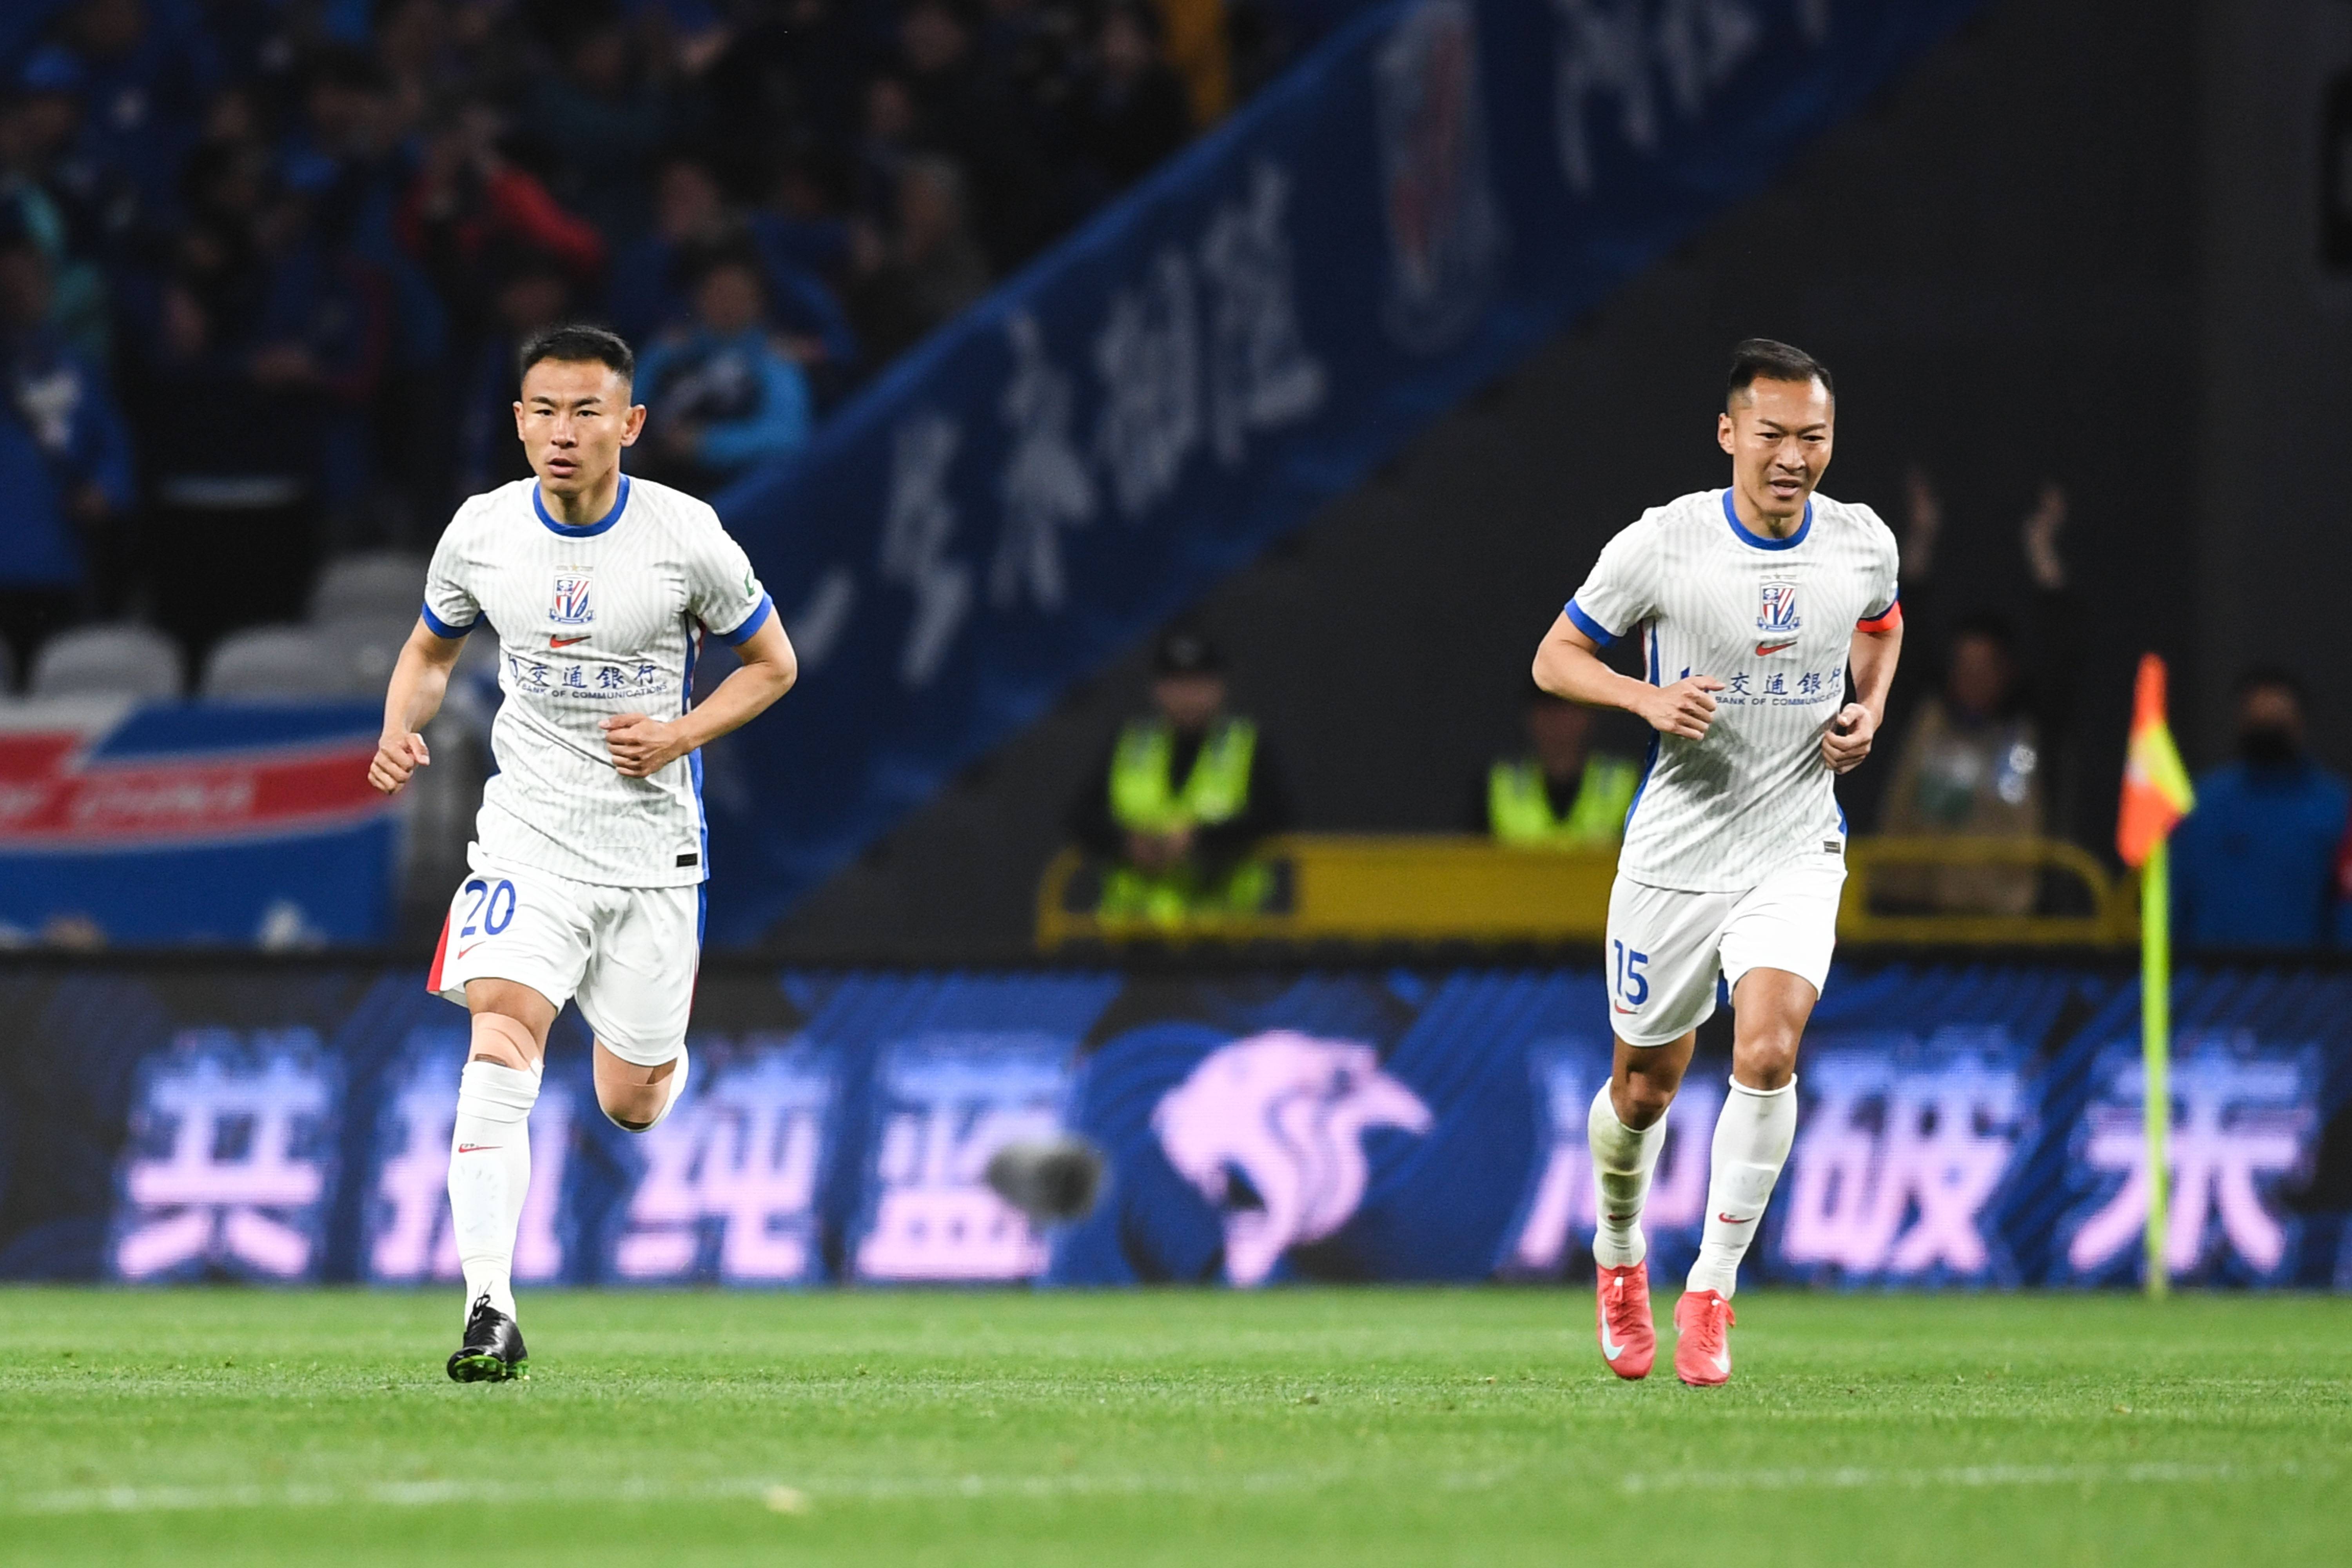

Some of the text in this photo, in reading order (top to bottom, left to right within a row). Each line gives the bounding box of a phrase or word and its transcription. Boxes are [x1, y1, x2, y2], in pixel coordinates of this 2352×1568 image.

[528, 664, 657, 689] 交通銀行
[1728, 667, 1841, 696] 交通銀行
[572, 682, 667, 699] COMMUNICATIONS
[1715, 696, 1746, 705] BANK
[460, 879, 516, 938] 20
[1613, 939, 1649, 1005] 15
